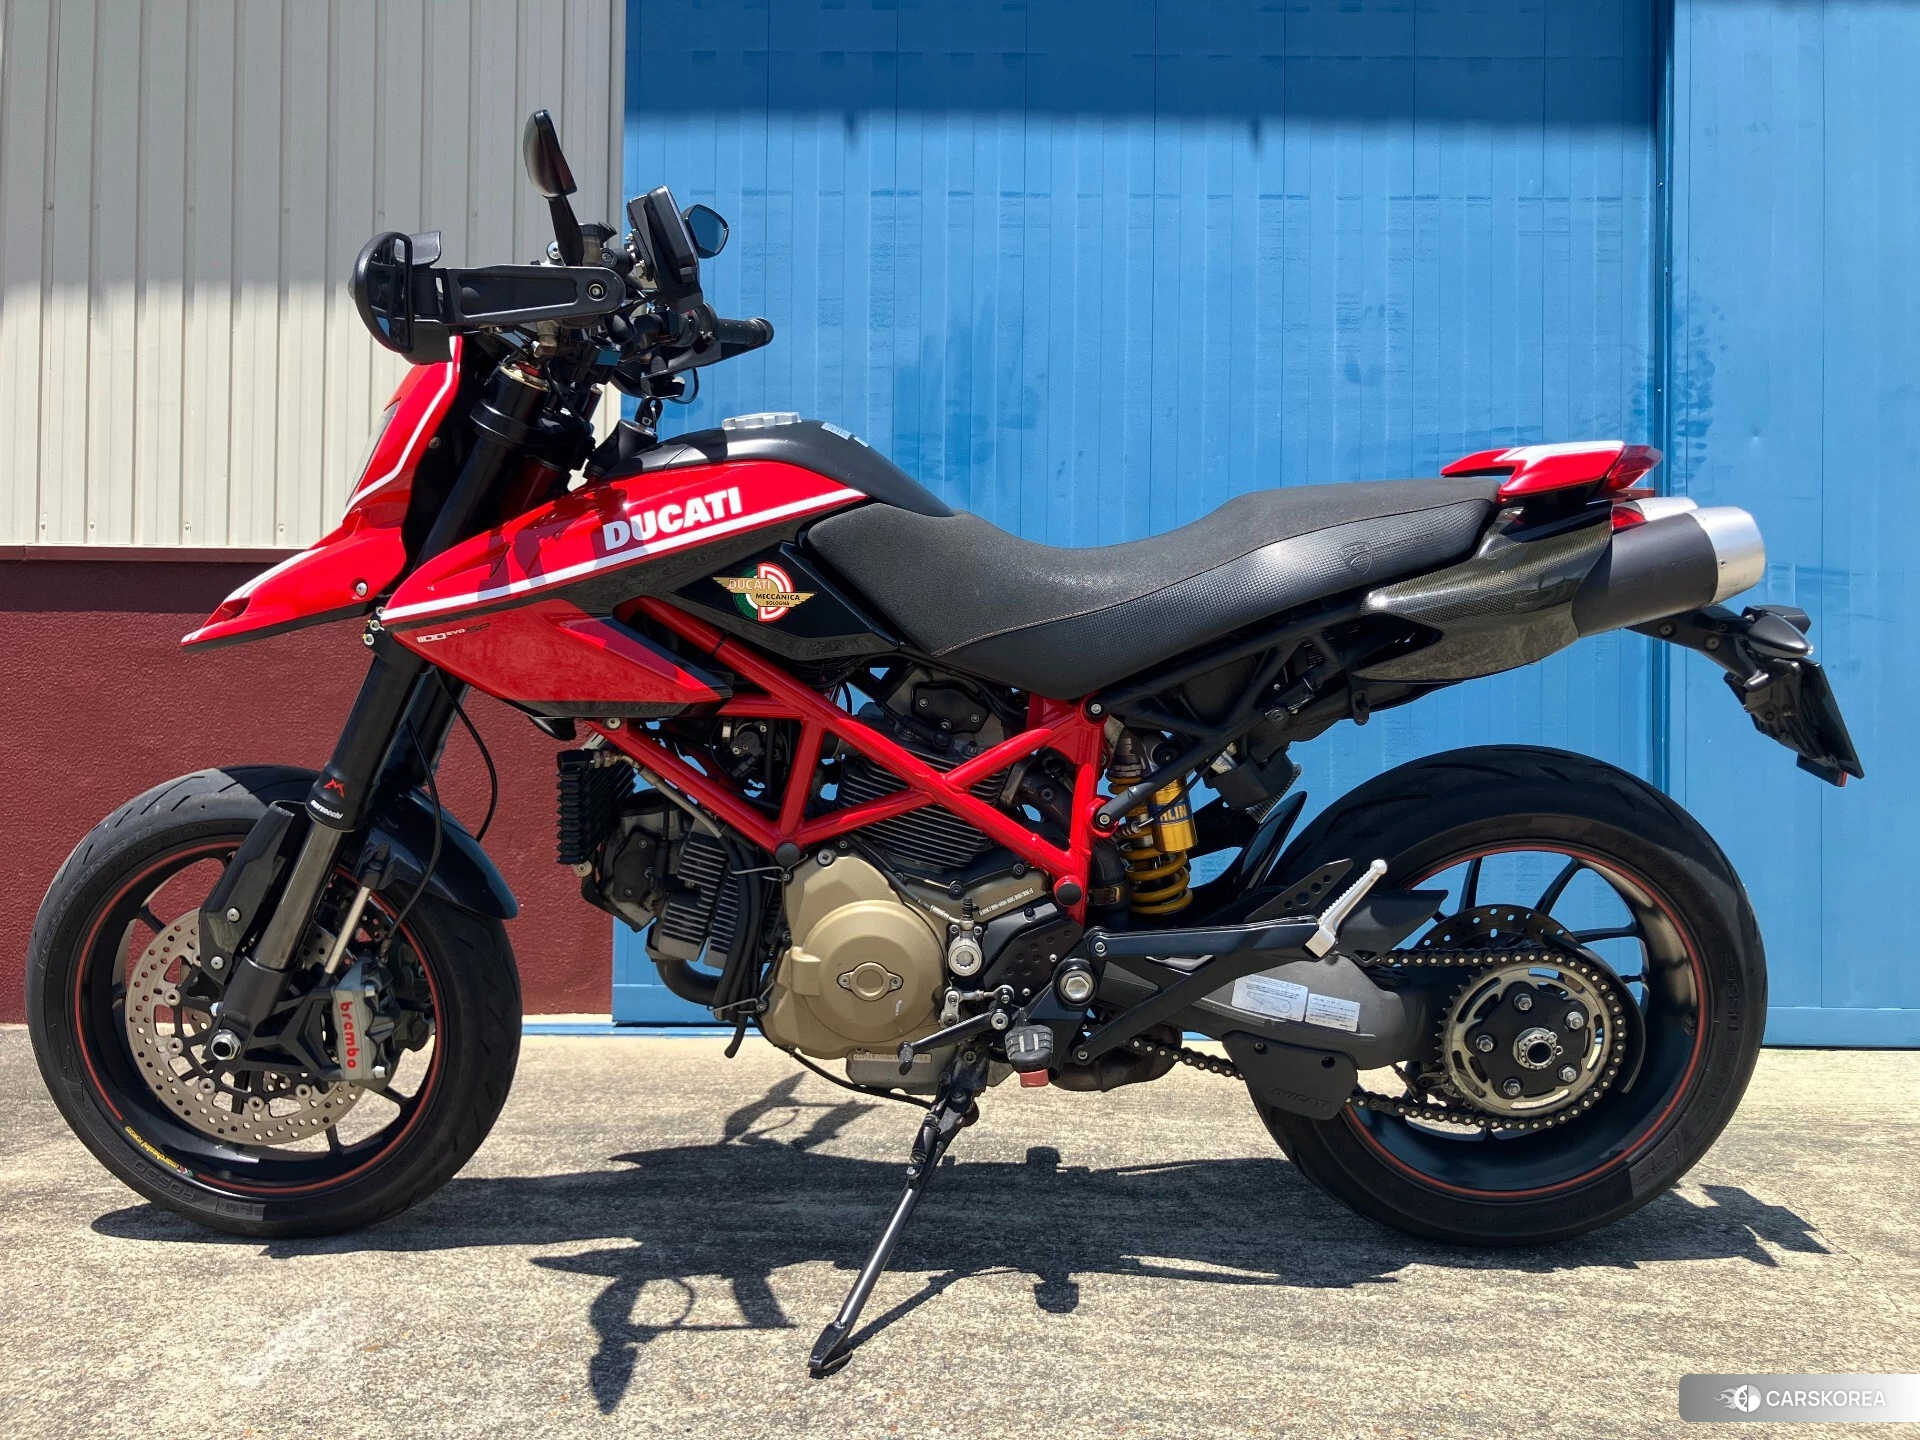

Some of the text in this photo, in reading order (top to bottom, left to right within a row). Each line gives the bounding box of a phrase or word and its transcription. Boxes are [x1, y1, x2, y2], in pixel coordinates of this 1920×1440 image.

[602, 486, 744, 551] DUCATI
[727, 579, 771, 590] DUCATI
[755, 593, 801, 601] MECCANICA
[446, 628, 466, 636] EVO
[310, 799, 344, 820] marzocchi
[1160, 804, 1188, 822] HLIN
[339, 1000, 361, 1069] brembo
